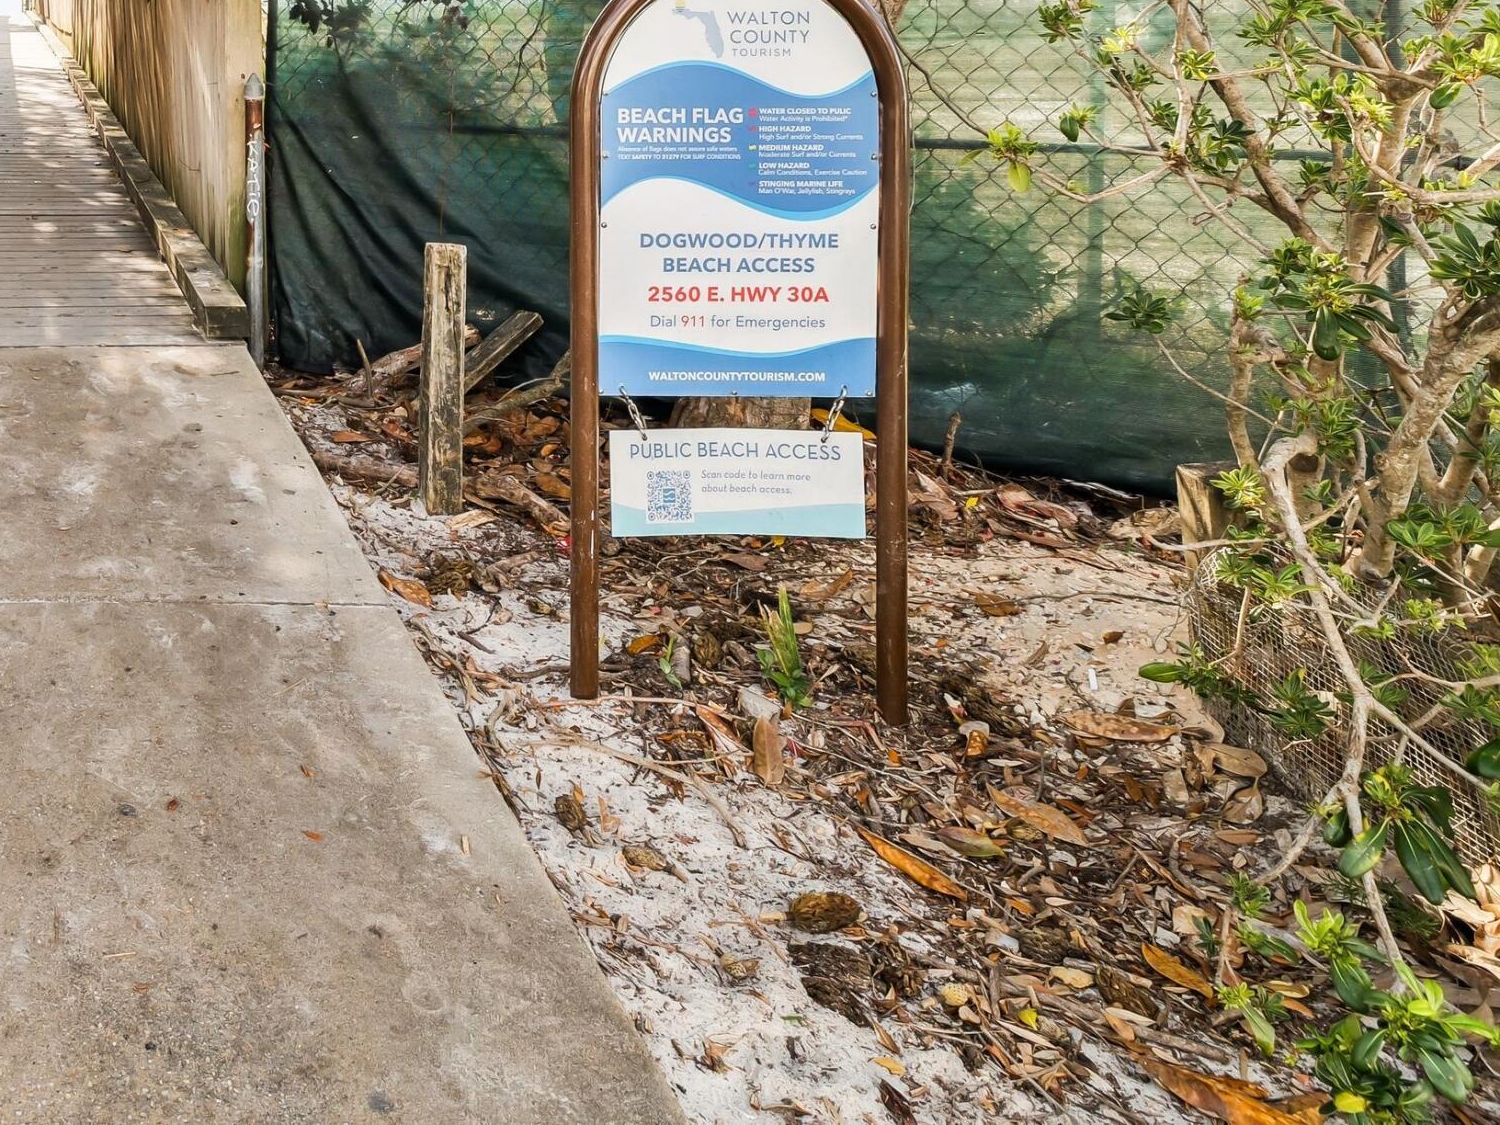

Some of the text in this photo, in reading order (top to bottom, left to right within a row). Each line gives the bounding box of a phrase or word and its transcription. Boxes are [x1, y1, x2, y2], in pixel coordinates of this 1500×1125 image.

[728, 11, 810, 25] WALTON
[730, 29, 810, 44] COUNTY
[732, 48, 791, 57] TOURISM
[617, 107, 744, 124] BEACH FLAG
[617, 127, 731, 143] WARNINGS
[640, 233, 839, 250] DOGWOOD/THYME
[663, 258, 815, 273] BEACH ACCESS
[648, 286, 829, 303] 2560 E. HWY 30A
[650, 315, 826, 331] Dial 911 for Emergencies
[649, 371, 826, 382] WALTONCOUNTYTOURISM.COM
[630, 442, 841, 460] PUBLIC BEACH ACCESS
[701, 470, 722, 479] Scan
[724, 470, 746, 479] code
[749, 470, 758, 480] to
[760, 470, 785, 480] learn
[701, 484, 792, 494] about beach access.
